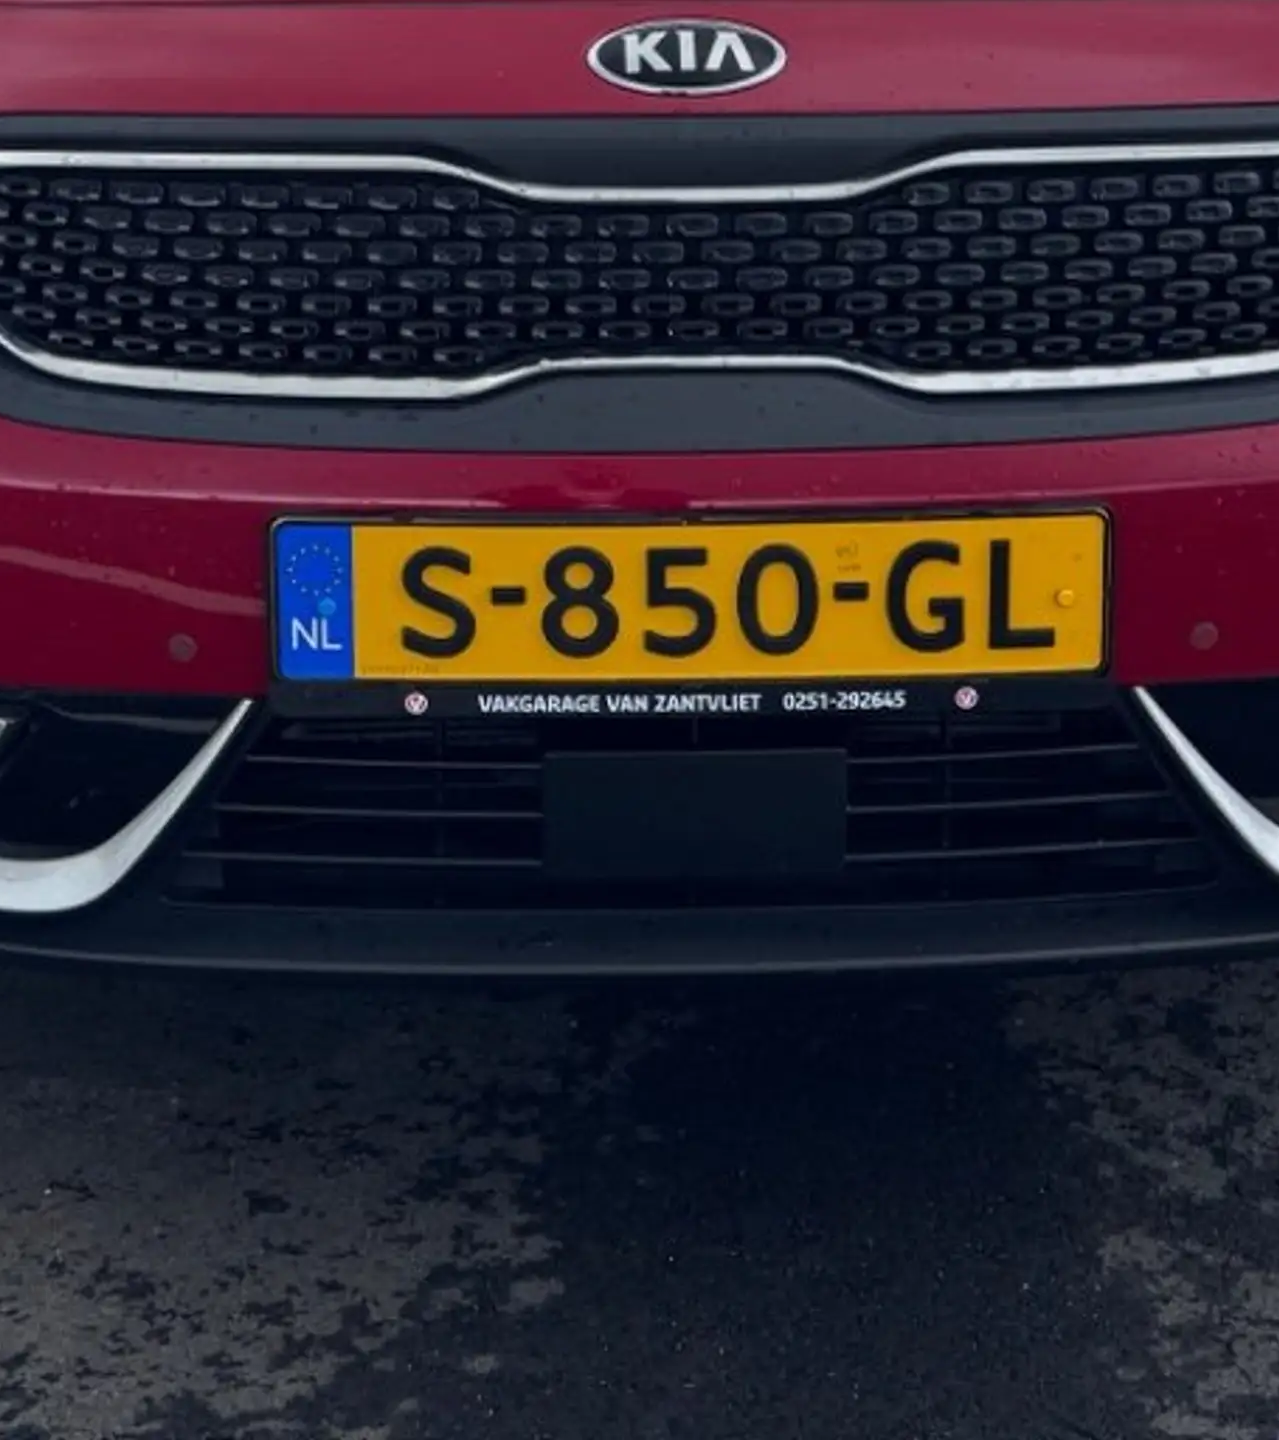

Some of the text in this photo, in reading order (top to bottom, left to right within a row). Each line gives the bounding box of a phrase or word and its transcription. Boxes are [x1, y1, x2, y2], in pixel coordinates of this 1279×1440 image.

[621, 29, 756, 74] KIA
[401, 539, 1056, 659] S-850-GL
[291, 617, 344, 651] NL
[477, 690, 907, 713] VAKGARAGE VAN ZANTVLIET 0251-292645
